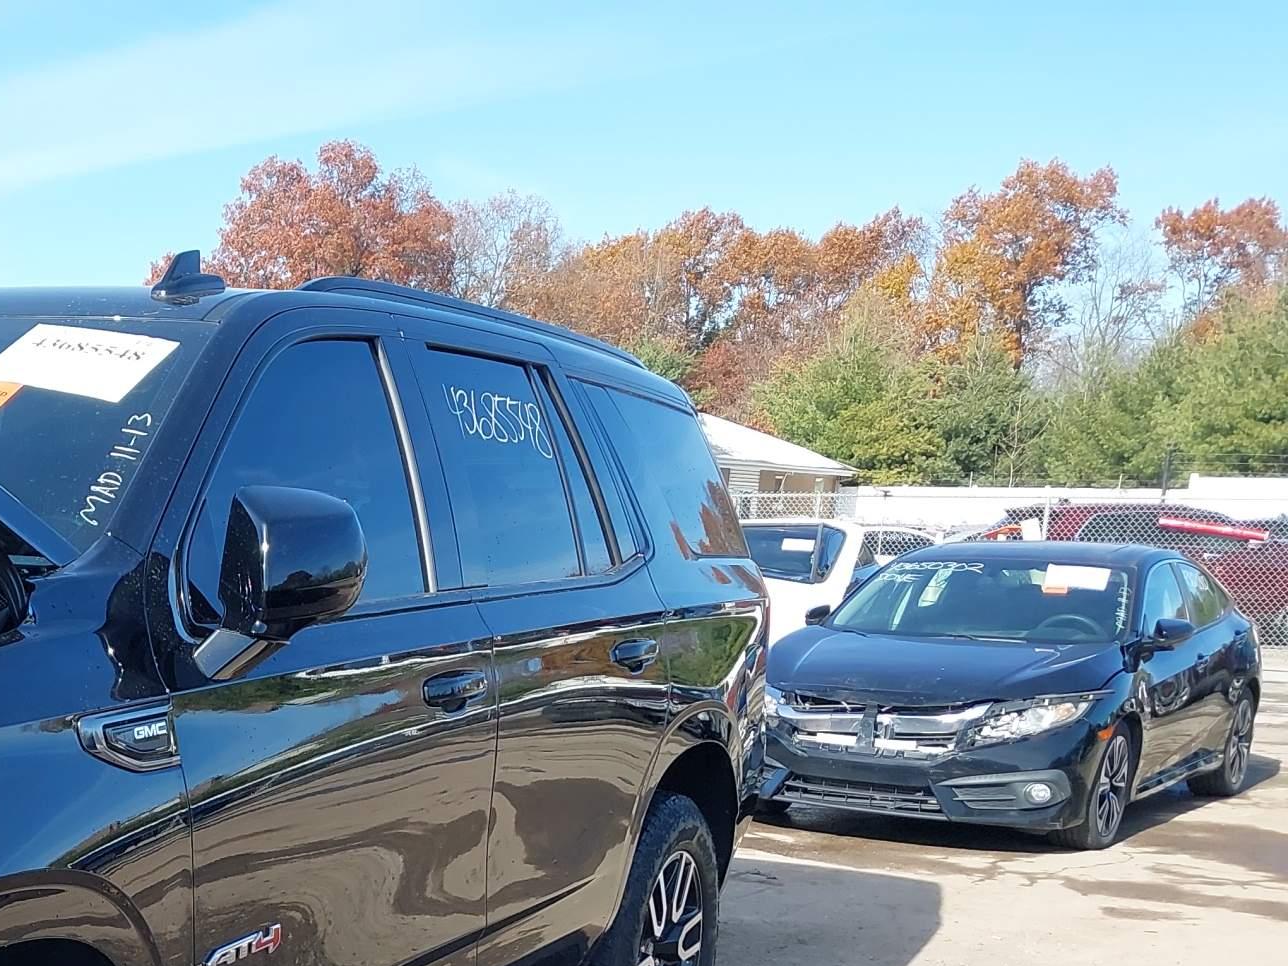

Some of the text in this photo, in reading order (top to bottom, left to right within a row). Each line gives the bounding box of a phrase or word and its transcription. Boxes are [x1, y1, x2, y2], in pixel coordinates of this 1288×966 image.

[442, 383, 553, 459] 43685548
[80, 412, 152, 526] MAD 11-13
[133, 720, 168, 740] GMC
